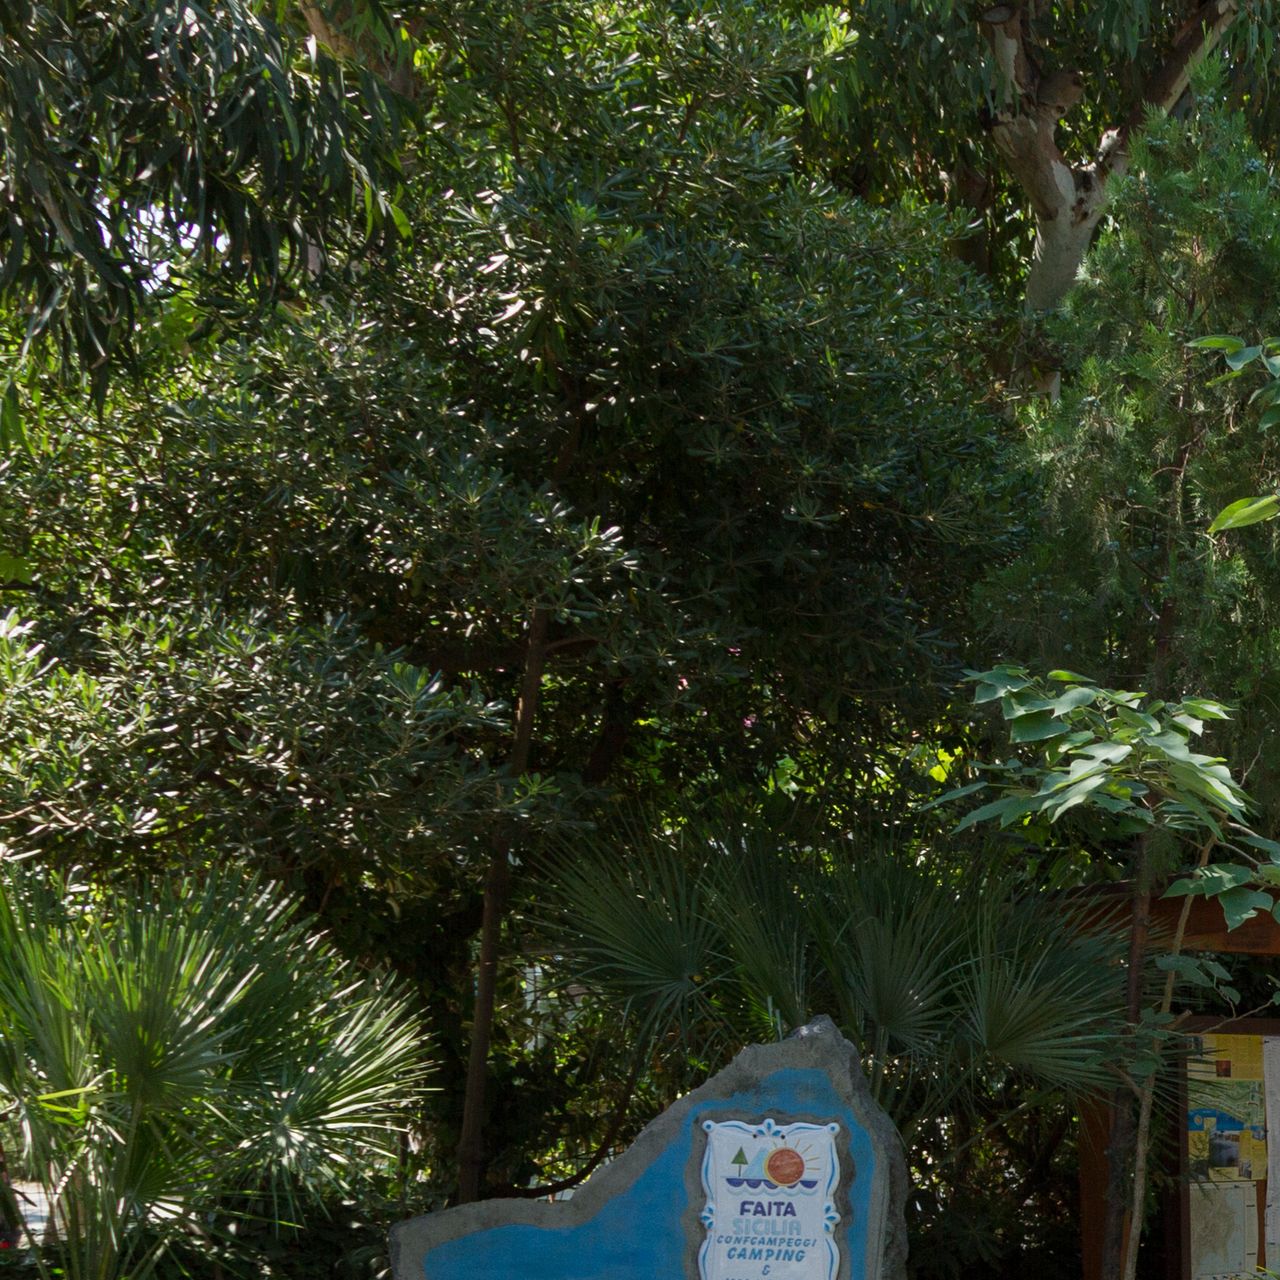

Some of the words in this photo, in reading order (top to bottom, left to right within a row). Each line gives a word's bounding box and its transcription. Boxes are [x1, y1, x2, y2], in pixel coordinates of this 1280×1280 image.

[740, 1201, 797, 1216] FAITA
[733, 1219, 801, 1235] SICILIA
[716, 1235, 817, 1247] CONFCAMPEGGI
[727, 1247, 806, 1262] CAMPING
